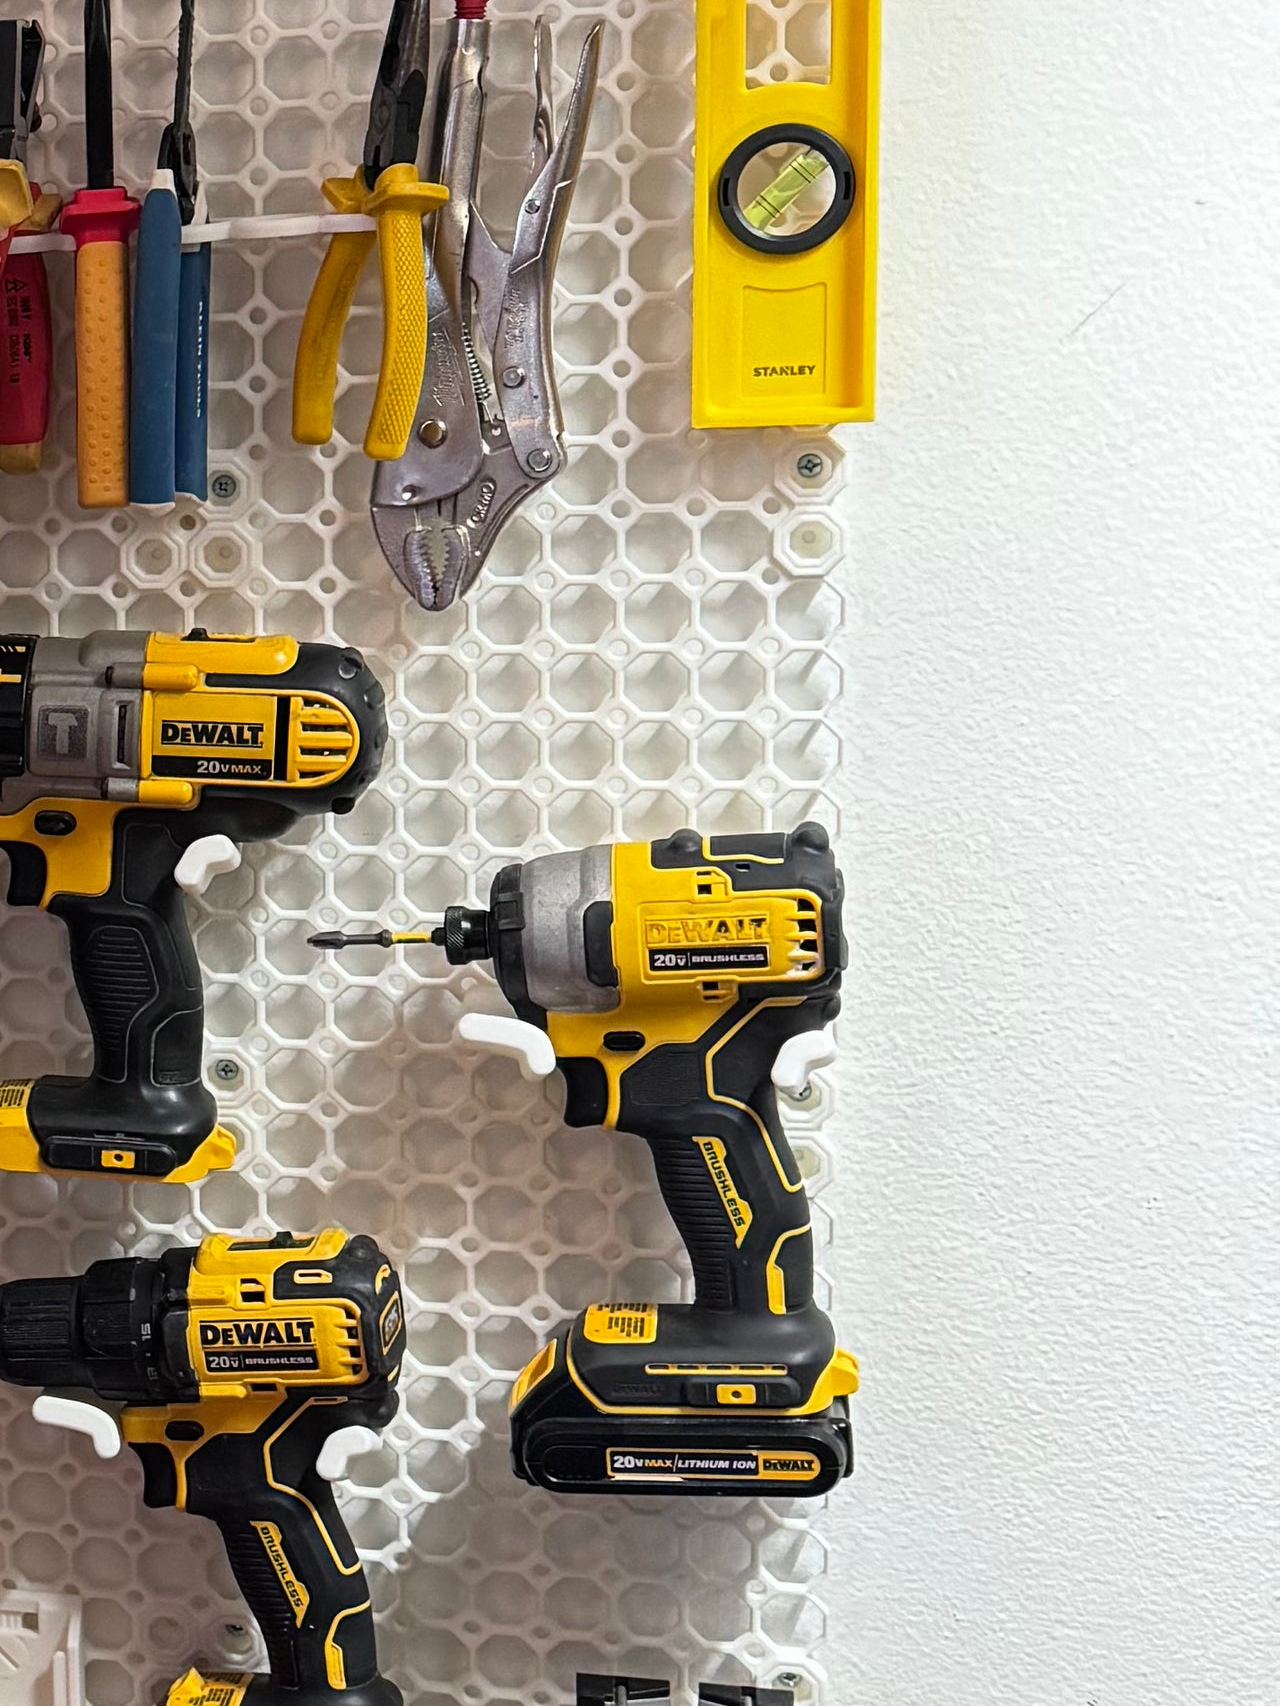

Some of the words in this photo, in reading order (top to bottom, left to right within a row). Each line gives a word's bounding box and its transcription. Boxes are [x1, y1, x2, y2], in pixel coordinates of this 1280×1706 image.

[753, 365, 816, 377] STANLEY
[161, 722, 264, 746] DEWALT
[646, 917, 768, 944] DEWALT
[692, 953, 765, 963] BRUSHLESS
[703, 1141, 746, 1227] BRUSHLESS
[199, 1322, 316, 1346] DEWALT
[245, 1356, 314, 1365] BRUSHLESS
[677, 1459, 730, 1469] LITHIUM
[732, 1461, 757, 1470] ION
[763, 1458, 815, 1471] DEWALT
[261, 1526, 304, 1608] BRUSHLESS
